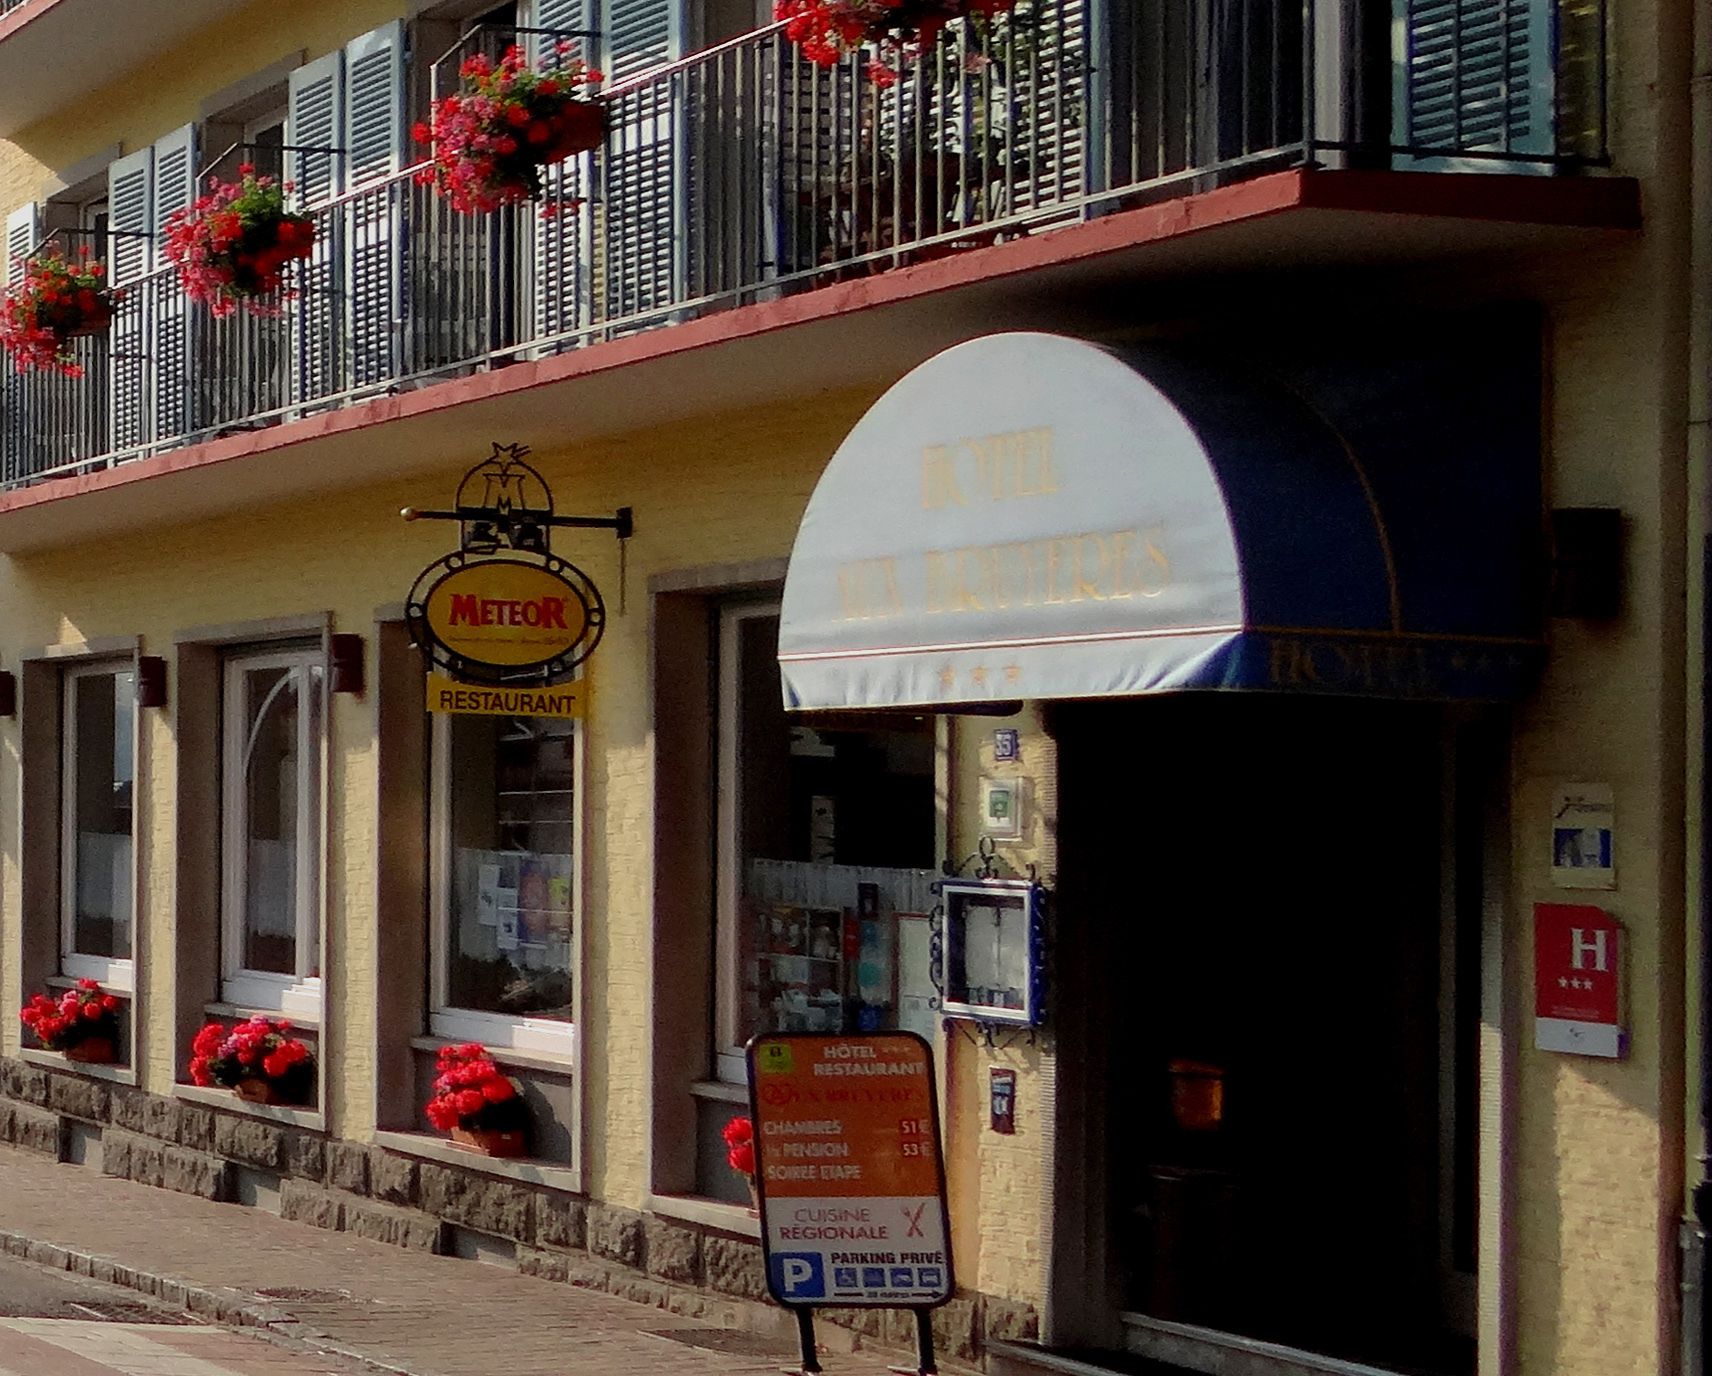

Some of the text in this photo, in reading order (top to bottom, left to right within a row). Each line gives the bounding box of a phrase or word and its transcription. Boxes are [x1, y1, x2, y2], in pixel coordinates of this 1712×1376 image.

[449, 593, 569, 630] METEOR
[440, 689, 576, 714] RESTAURANT
[1569, 927, 1609, 972] H
[824, 1043, 877, 1059] HÔTEL
[814, 1061, 926, 1077] RESTAURANT
[783, 1142, 849, 1158] PENSION
[830, 1252, 896, 1265] PARKING
[783, 1258, 813, 1293] P
